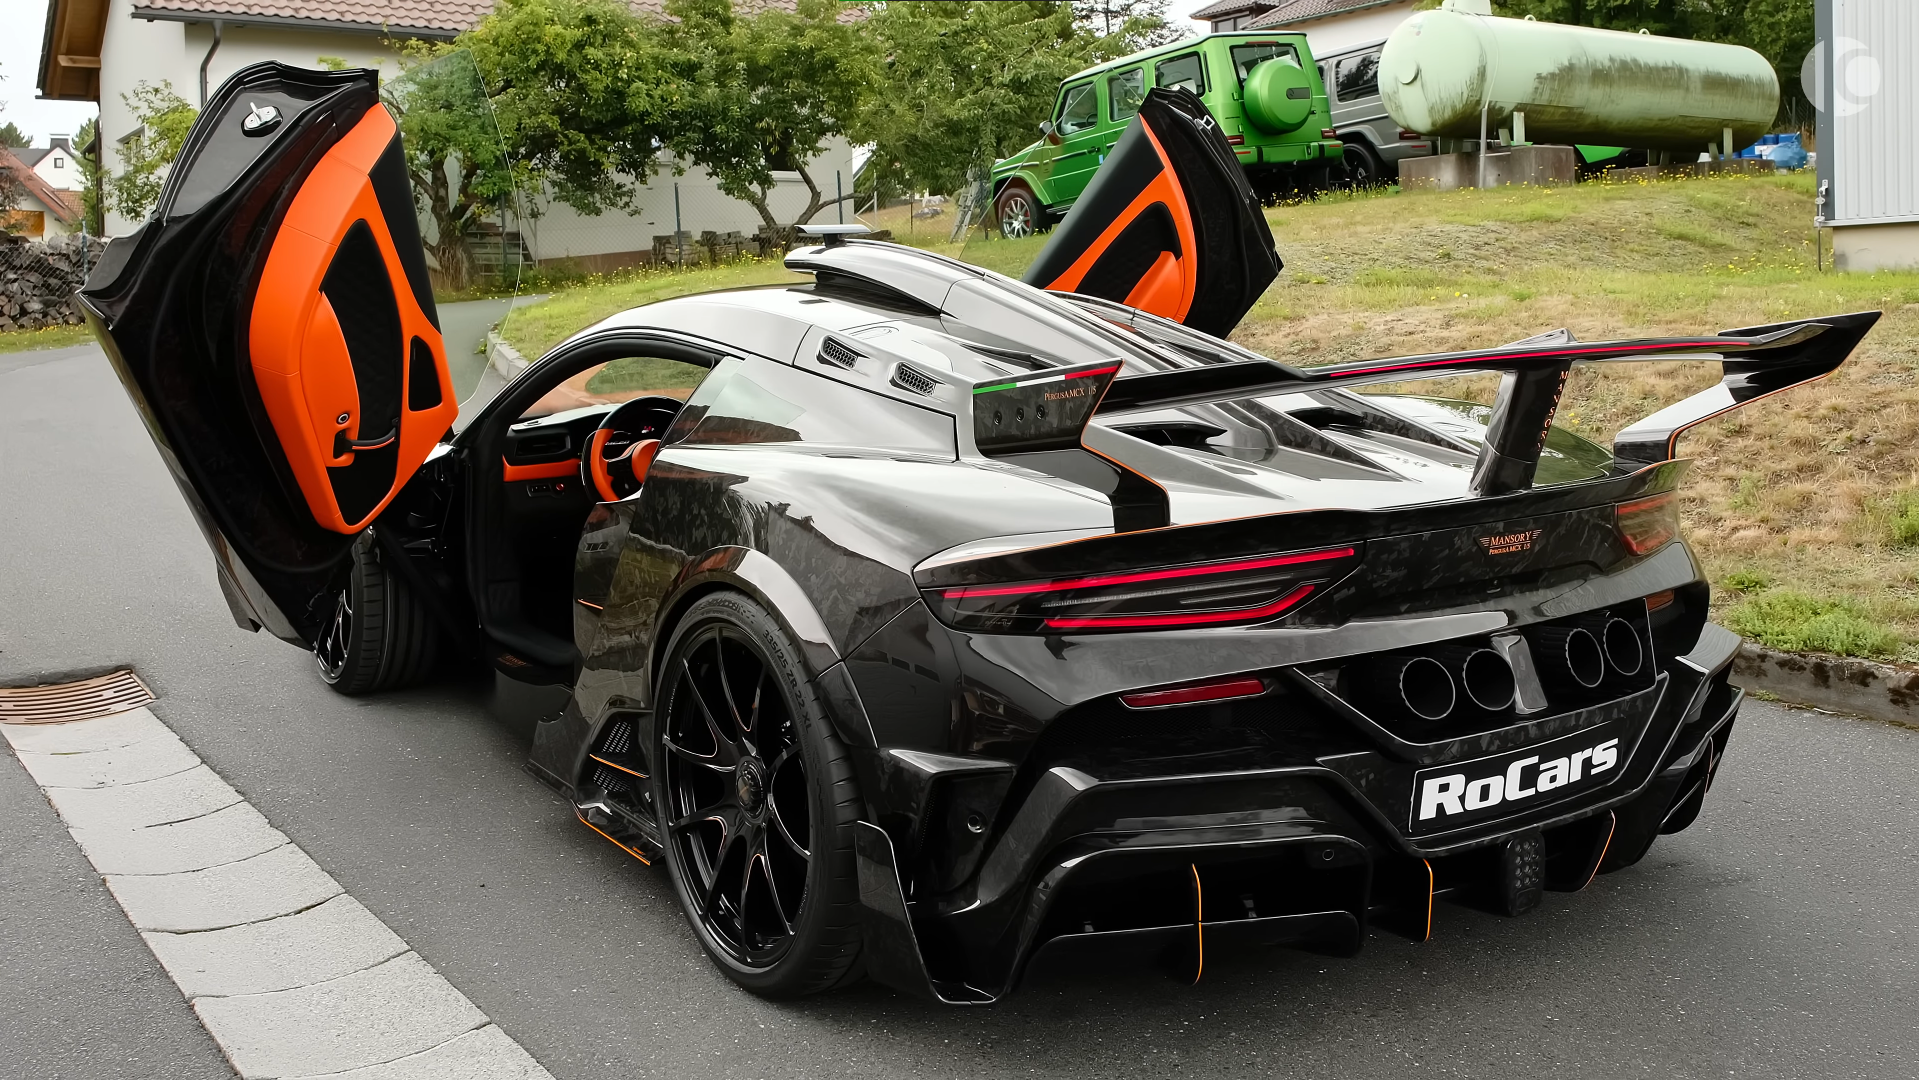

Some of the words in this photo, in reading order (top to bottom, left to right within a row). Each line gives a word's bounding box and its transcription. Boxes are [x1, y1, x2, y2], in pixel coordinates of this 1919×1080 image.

[1490, 531, 1532, 546] MANSORY
[763, 630, 789, 669] 335/25
[786, 669, 798, 691] ZR
[795, 691, 806, 710] 22
[802, 711, 813, 734] XL
[1419, 738, 1619, 821] RoCars
